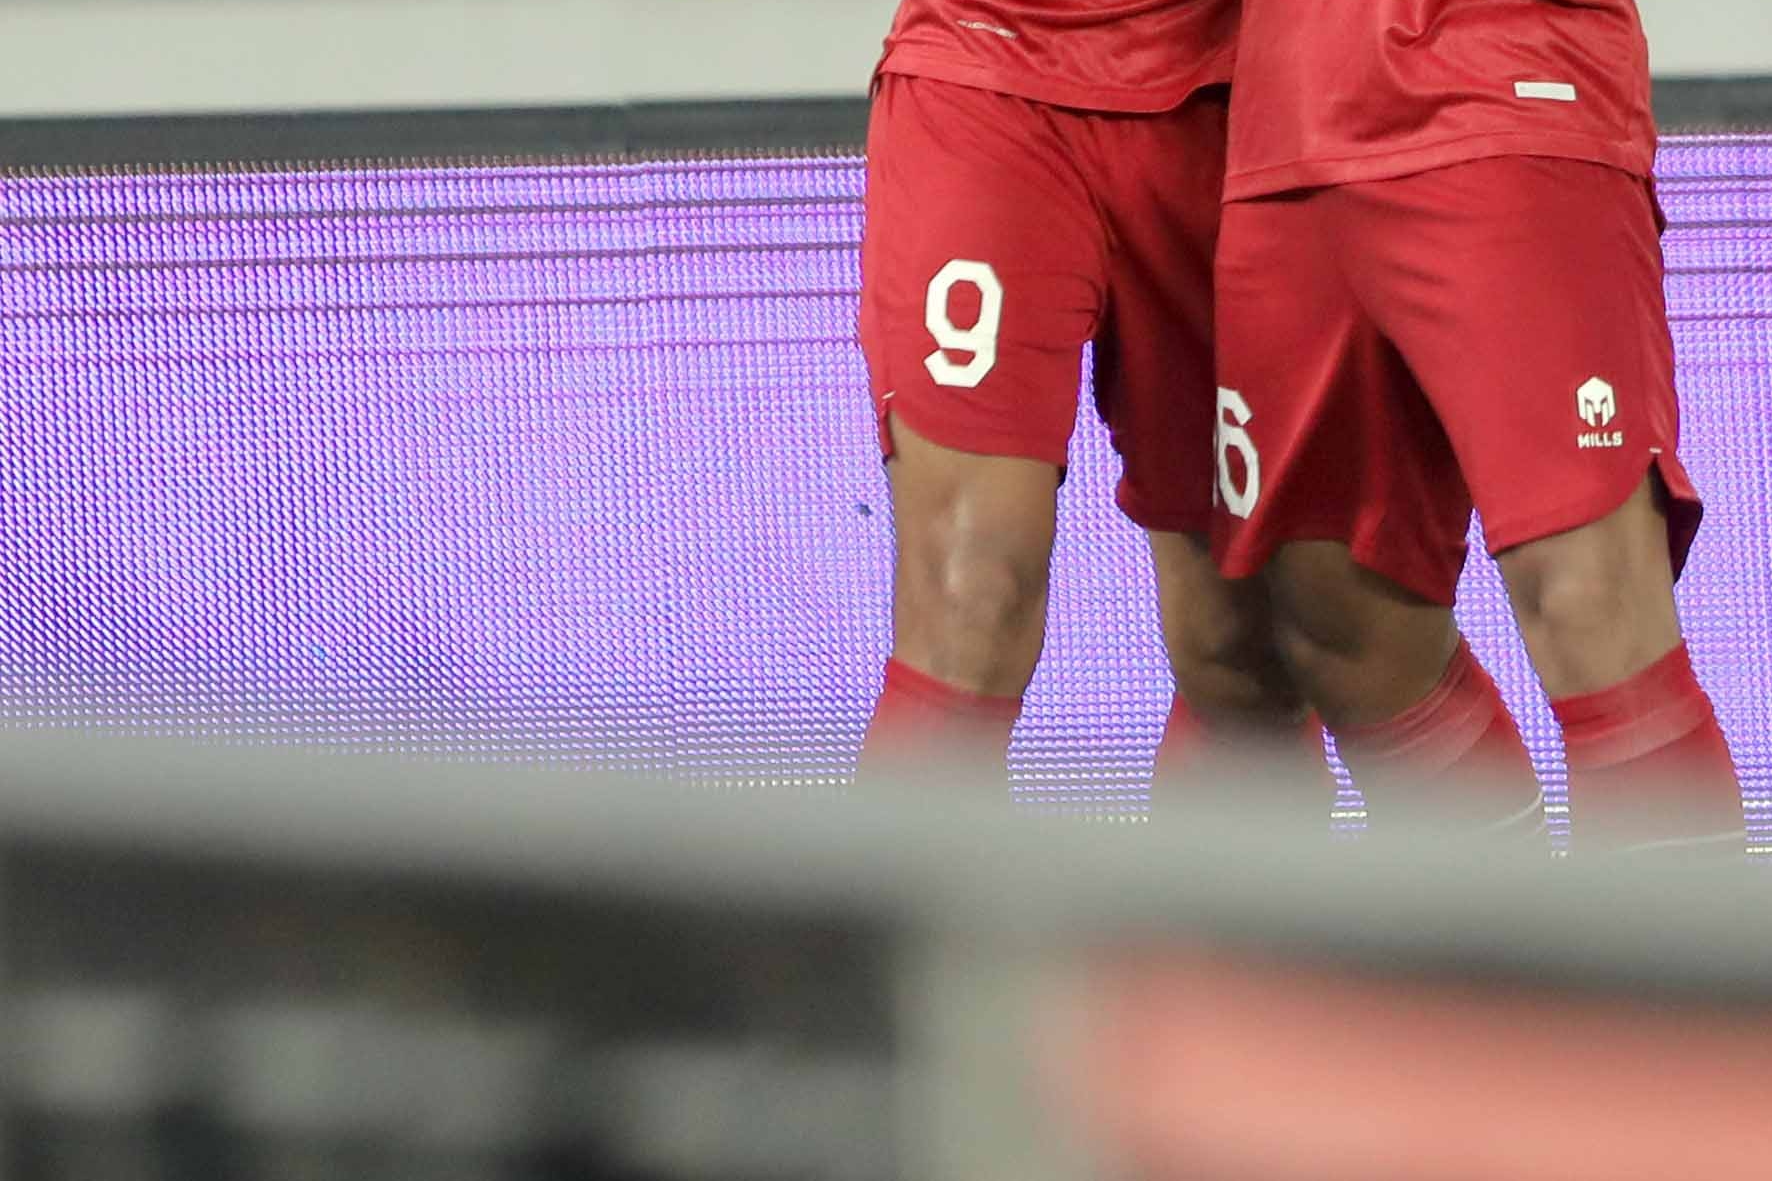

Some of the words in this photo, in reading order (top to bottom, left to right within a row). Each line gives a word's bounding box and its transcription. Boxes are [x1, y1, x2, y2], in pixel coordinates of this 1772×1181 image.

[923, 259, 1004, 389] 9
[1213, 386, 1260, 520] 6
[1577, 430, 1623, 449] MILLS
